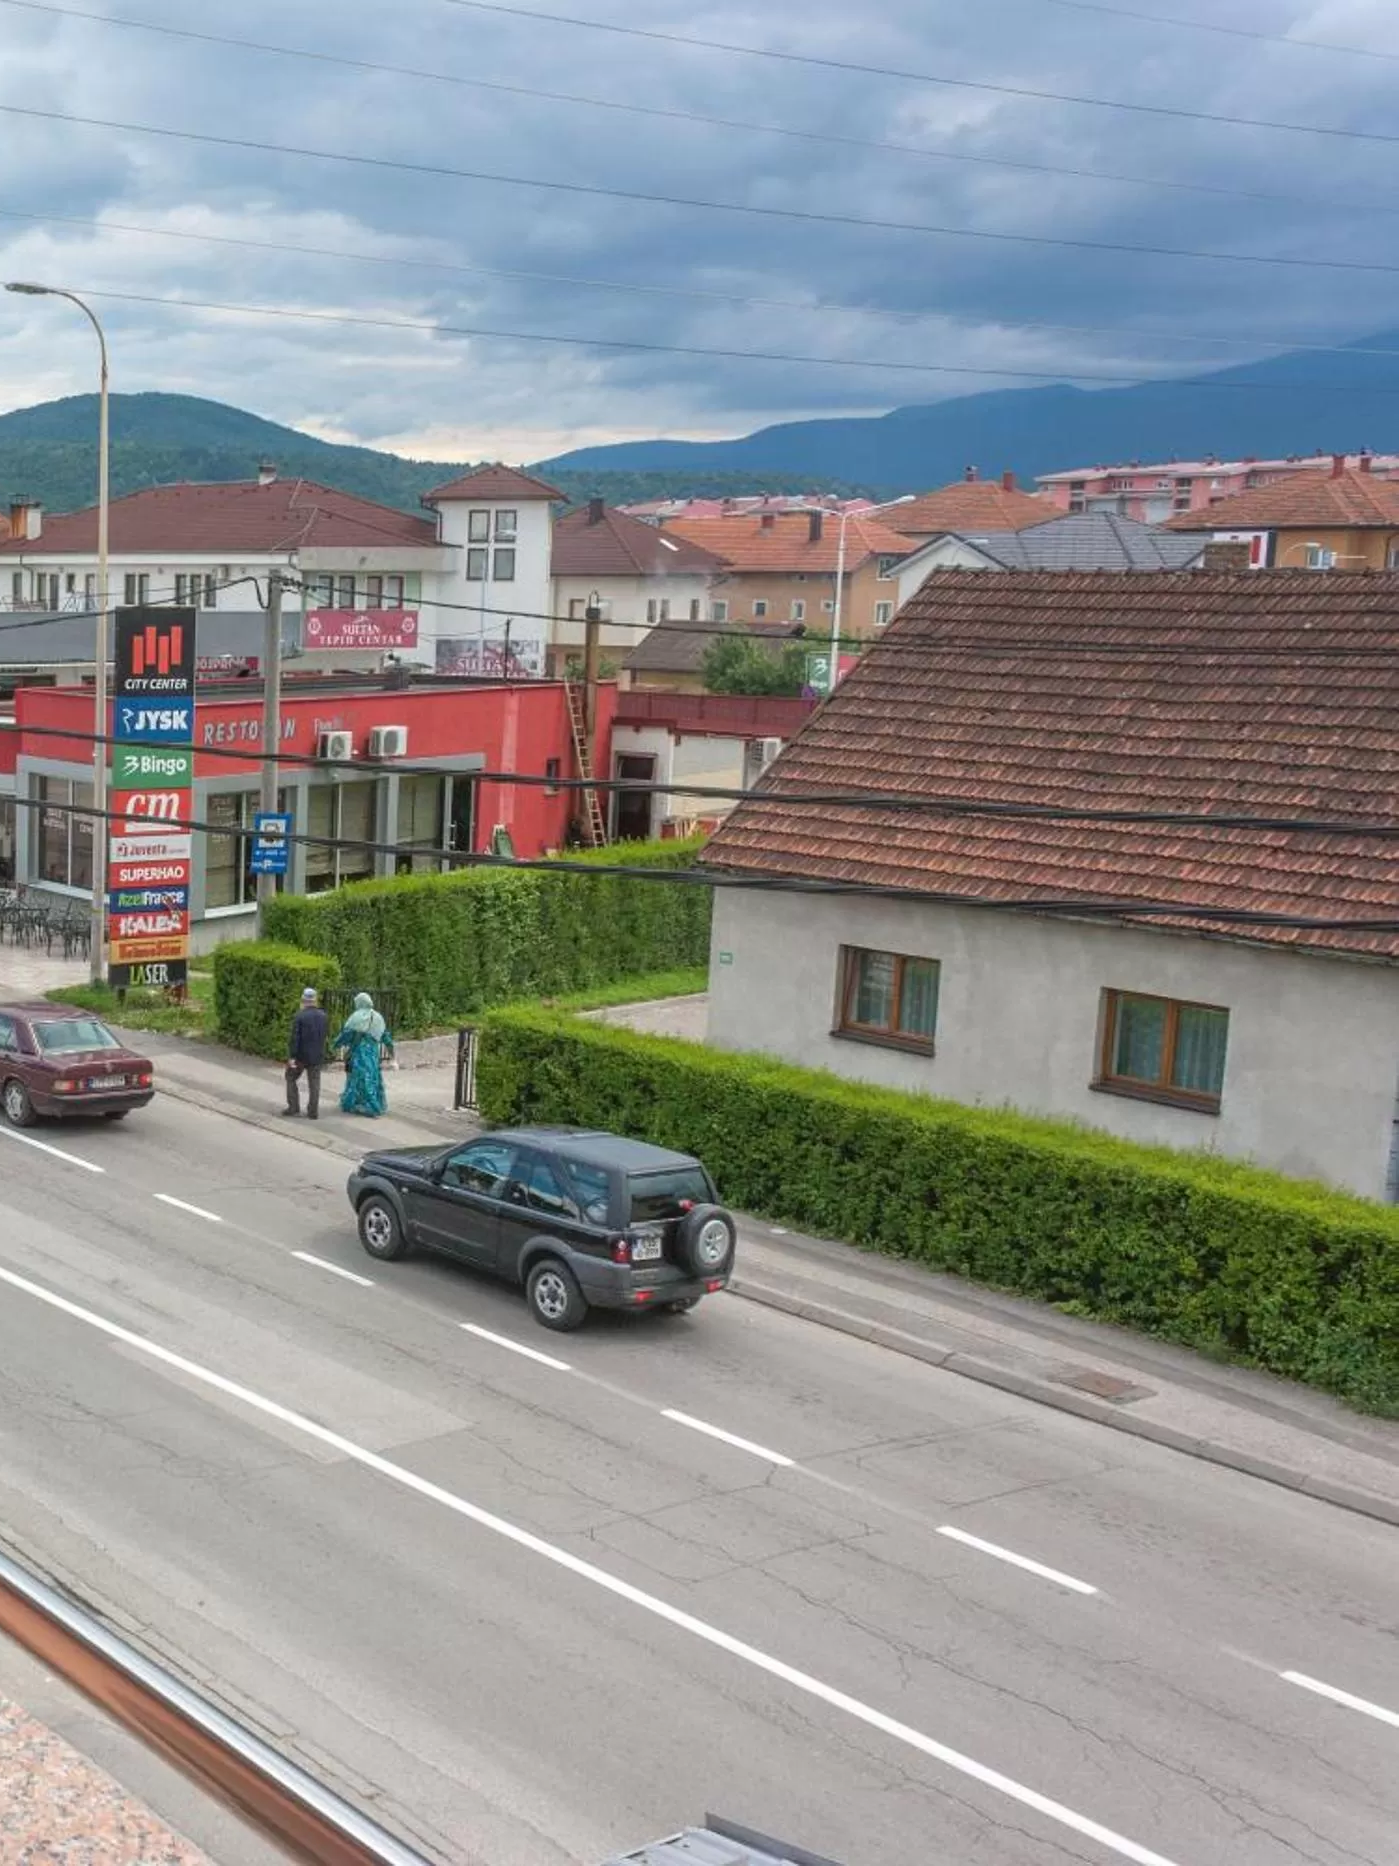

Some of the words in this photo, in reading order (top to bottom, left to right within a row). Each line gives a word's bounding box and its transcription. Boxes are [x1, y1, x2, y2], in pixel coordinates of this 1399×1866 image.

[124, 678, 149, 690] CITY
[150, 678, 188, 690] CENTER
[134, 709, 189, 731] JYSK
[204, 717, 296, 746] RESTON
[140, 755, 187, 776] Bingo
[129, 963, 169, 986] LASER
